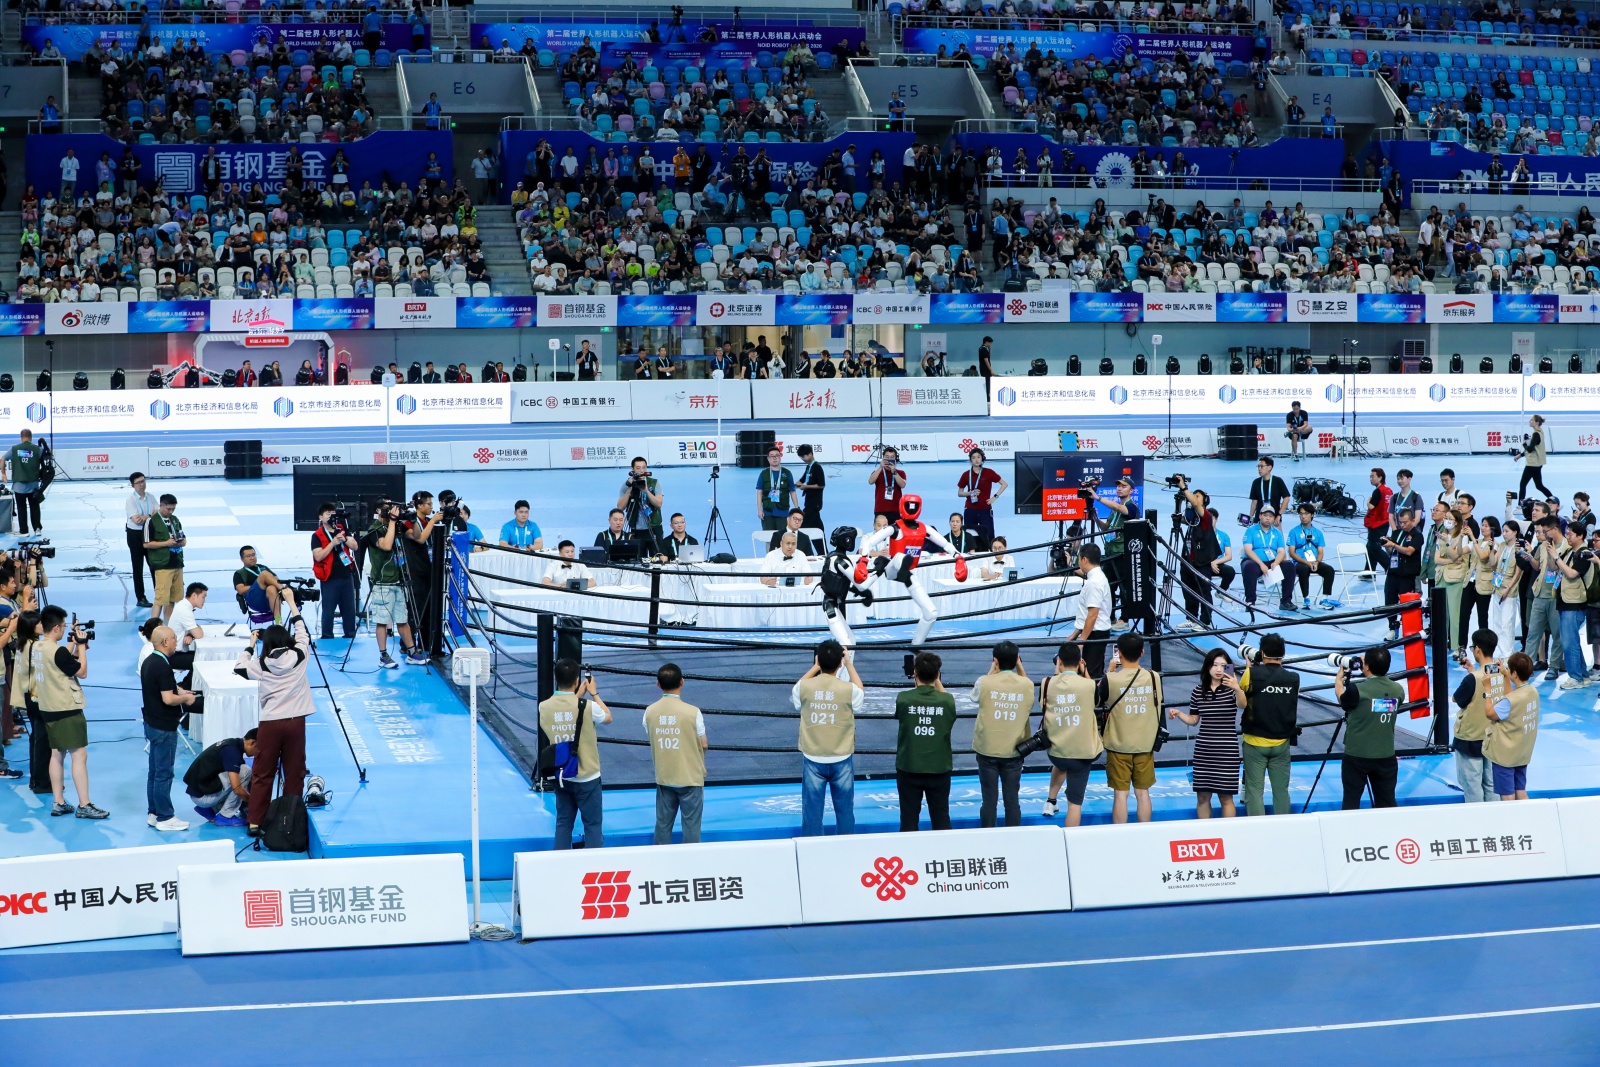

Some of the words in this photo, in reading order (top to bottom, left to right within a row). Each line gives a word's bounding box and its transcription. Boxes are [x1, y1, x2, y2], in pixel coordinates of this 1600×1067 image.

[100, 30, 206, 39] 第二届世界形机器人运动会
[279, 29, 386, 38] 第二届世界人形机器人
[547, 30, 642, 38] 第二届世界人形机器人运动
[721, 31, 822, 40] 第二届世界人形机器人运动会
[975, 35, 1072, 45] 第二届世界人形机器人运动会
[1138, 39, 1232, 49] 第二届世界人形机器人运动会
[453, 82, 475, 95] E6
[898, 84, 918, 97] E5
[1312, 93, 1332, 106] E4
[653, 160, 819, 183] 中人保险
[203, 181, 284, 193] SOUGNG
[406, 303, 425, 312] BRTV
[564, 303, 607, 314] 首钢基金
[727, 303, 763, 313] 北京证券
[856, 305, 872, 313] ICBC
[885, 304, 923, 313] 中国工商银行
[1029, 300, 1059, 309] 中国联通
[1147, 303, 1164, 312] PICC
[1165, 303, 1213, 312] 中国人民保险
[1312, 300, 1348, 311] 慧之安
[1443, 307, 1475, 317] 京东服务
[83, 312, 111, 326] 微博
[915, 388, 962, 400] 首钢基金
[1021, 389, 1096, 399] 北京市经济和信息化局
[1132, 388, 1206, 398] 北京市经济和信息化局
[1241, 387, 1313, 397] 北京市经济和信息化局
[1347, 386, 1417, 396] 北京市经济和信息化局
[1450, 386, 1518, 395] 北京市经济和信息化局
[299, 398, 382, 408] 北京市经济和信息化局
[422, 397, 503, 407] 北京市经济和信息化局
[520, 398, 543, 408] ICBC
[562, 397, 616, 407] 中国工商银行
[689, 394, 719, 409] 京东
[789, 388, 837, 410] 北京日报
[52, 404, 134, 415] 北京市经济和信息化局
[175, 401, 258, 412] 北京市经济和信息化局
[980, 439, 1009, 448] 中国联通
[1163, 437, 1192, 445] 中国联通
[1392, 438, 1409, 446] ICBC
[1421, 437, 1460, 446] 中国工商银行
[1503, 434, 1522, 444] 北京
[496, 448, 528, 457] 中国联通
[586, 445, 627, 456] 首钢基金
[786, 444, 823, 454] 北资
[851, 444, 870, 454] PICC
[872, 443, 929, 453] 中人民保险
[89, 454, 108, 463] BRTV
[281, 454, 341, 464] 中国人民保险
[389, 449, 431, 460] 首钢基金
[680, 451, 718, 461] 北奥集团
[157, 459, 176, 467] ICBC
[193, 458, 223, 467] 中国工商
[813, 690, 835, 702] 摄影
[989, 690, 1024, 702] 官方摄影
[1118, 686, 1153, 696] 官方摄影
[1055, 693, 1077, 705] 摄影
[1124, 695, 1148, 704] PHOTO
[810, 702, 839, 711] PHOTO
[993, 701, 1019, 710] PHOTO
[1053, 705, 1082, 714] PHOTO
[1125, 703, 1147, 714] 016
[907, 705, 944, 717] 主转播商
[993, 710, 1017, 722] 019
[553, 711, 574, 723] 摄影
[658, 714, 677, 726] 摄影
[810, 712, 836, 725] 021
[918, 716, 932, 725] HB
[1055, 714, 1081, 728] 119
[1380, 712, 1392, 724] 07
[551, 724, 577, 732] PHOTO
[655, 727, 681, 736] PHOTO
[914, 726, 936, 737] 096
[657, 737, 680, 750] 102
[1429, 833, 1534, 857] 中国工商银行
[1176, 841, 1219, 861] BRTV
[1344, 845, 1391, 864] ICBC
[925, 855, 1008, 879] 中国联通
[1161, 867, 1241, 884] 北京广播电视台
[926, 878, 963, 894] China
[963, 877, 1010, 893] unicom
[637, 876, 745, 906] 北京国资
[0, 891, 48, 918] PICC
[289, 884, 405, 916] 首钢基金
[290, 913, 367, 928] SHOUGANG
[370, 912, 407, 925] FUND
